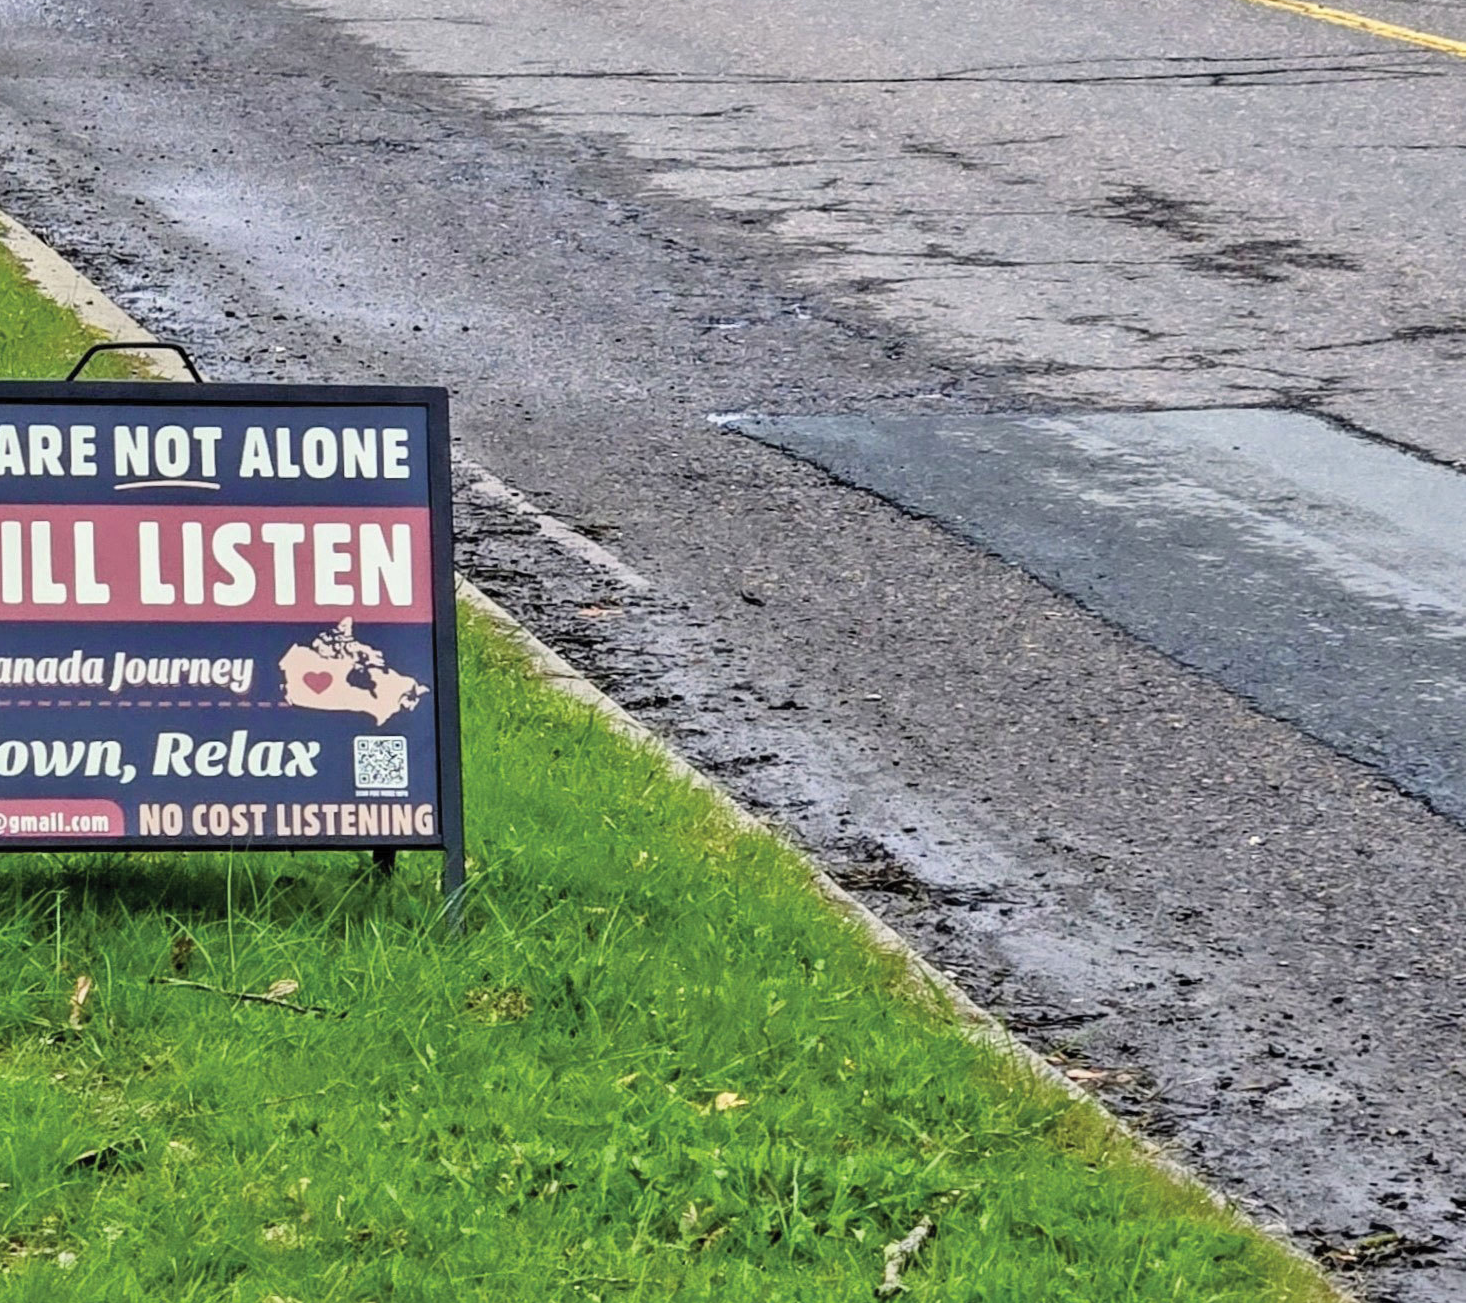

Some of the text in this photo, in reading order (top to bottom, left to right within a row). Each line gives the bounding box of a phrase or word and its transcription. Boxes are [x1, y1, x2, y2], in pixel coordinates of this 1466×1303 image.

[114, 425, 222, 478] NOT
[239, 426, 410, 479] ALONE
[138, 521, 413, 607] LISTEN
[108, 651, 254, 694] Journey
[152, 729, 321, 777] Relax
[139, 803, 434, 837] NO COST LISTENING
